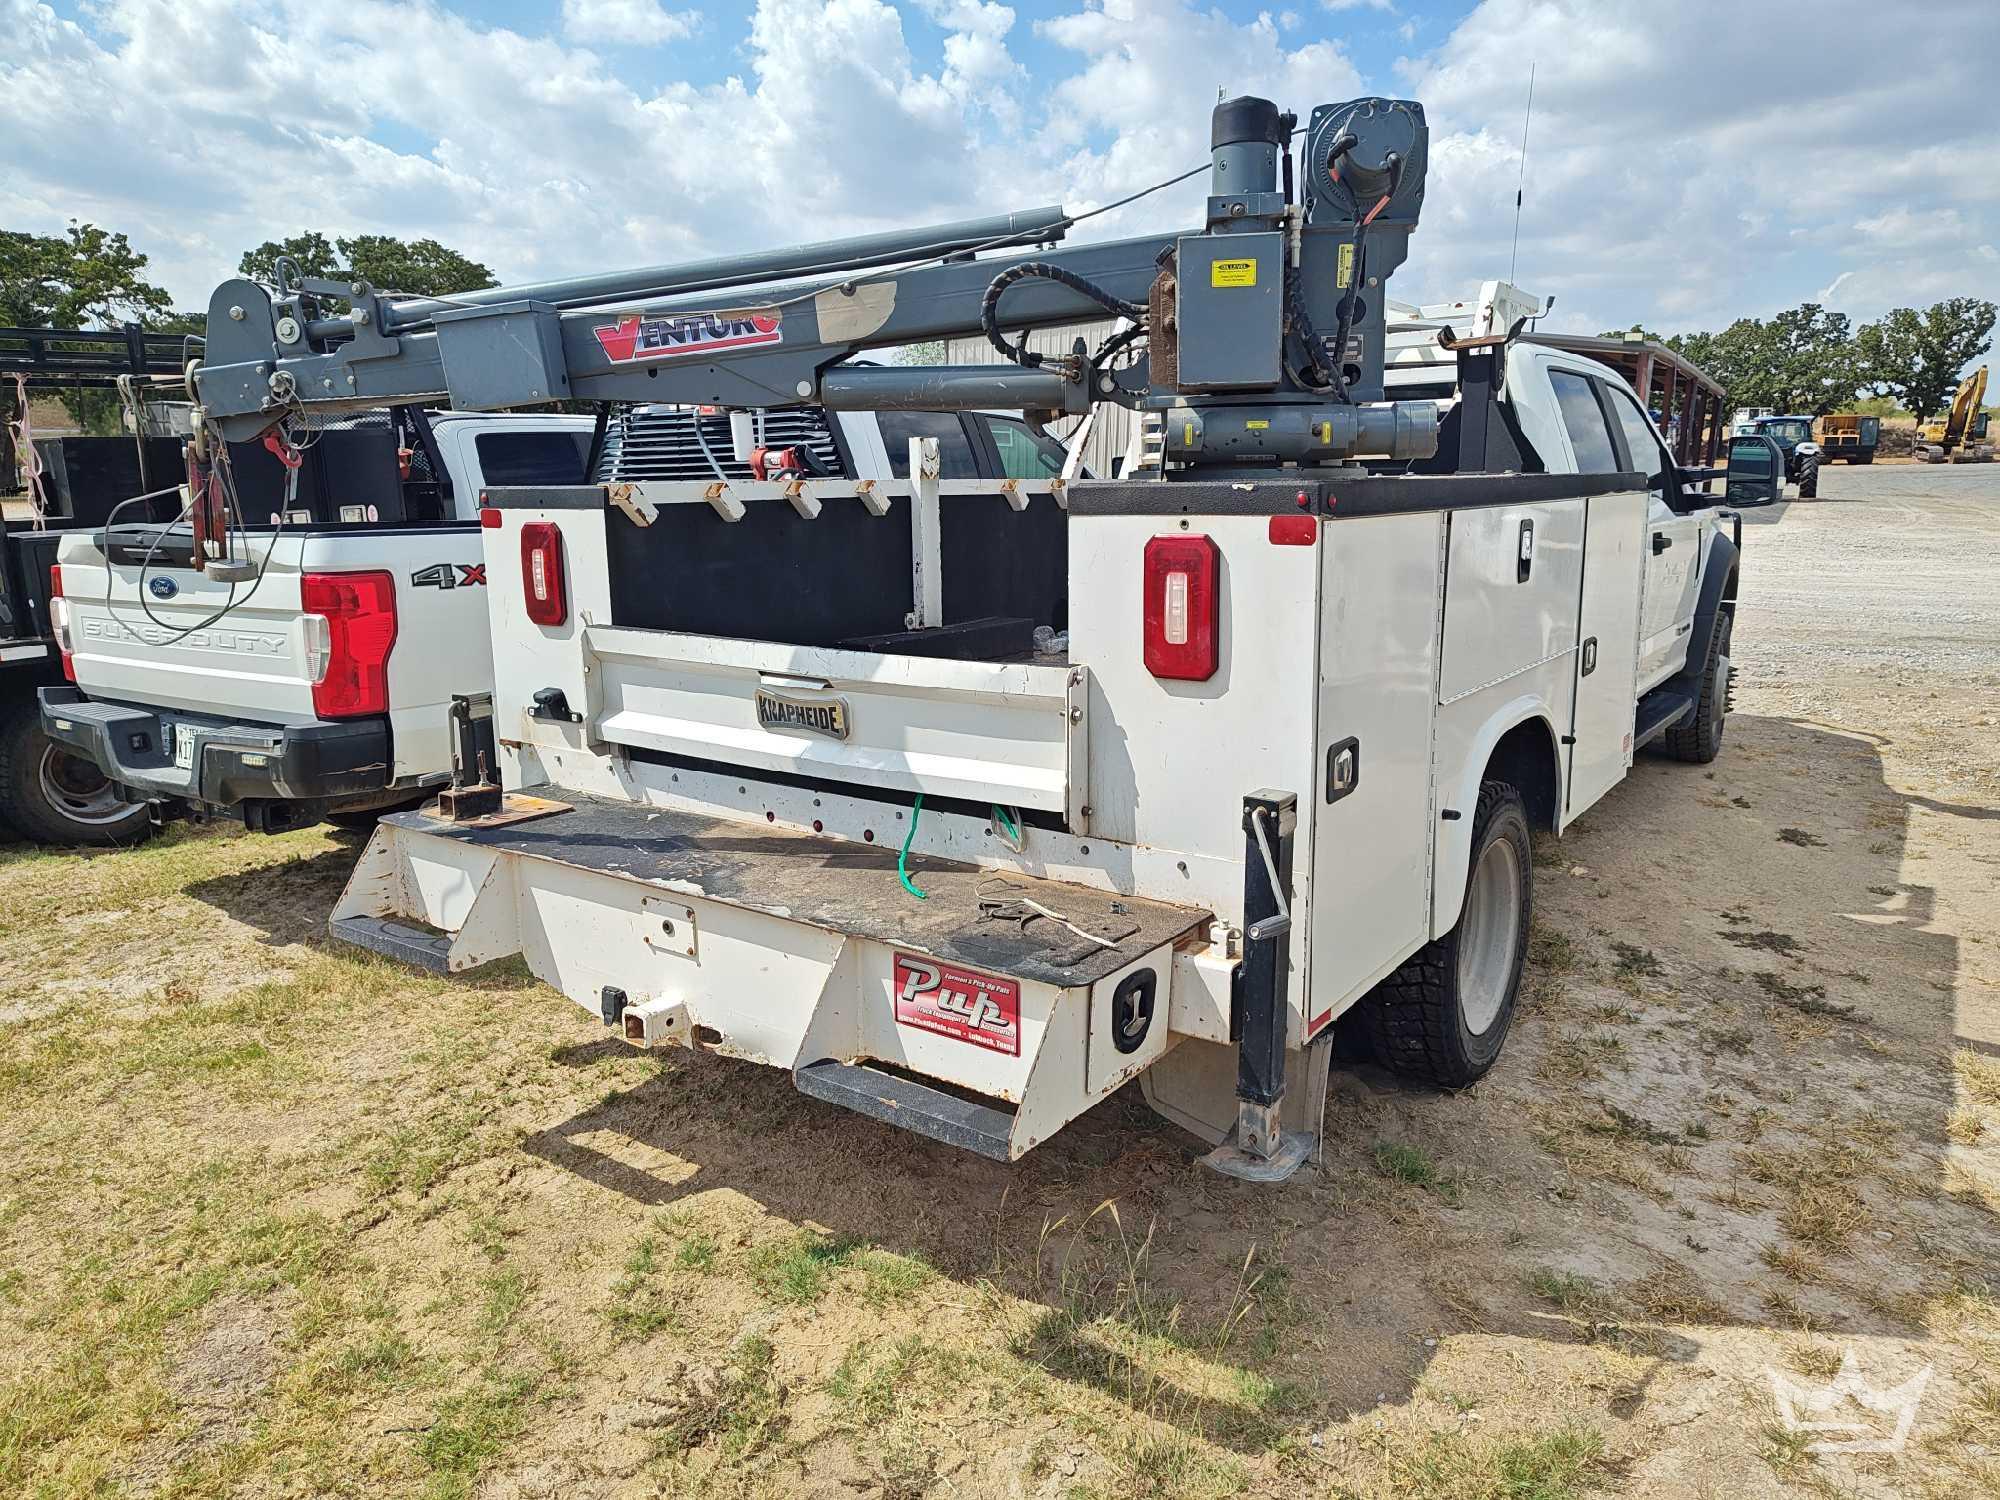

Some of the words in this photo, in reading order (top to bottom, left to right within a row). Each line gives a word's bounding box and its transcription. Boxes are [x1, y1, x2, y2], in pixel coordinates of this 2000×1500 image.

[595, 314, 780, 361] VENTURO
[86, 620, 182, 647] SUPER
[190, 631, 285, 653] DUTY
[758, 694, 840, 733] KNAPHEIDE
[898, 958, 1010, 1030] Pup
[995, 1039, 1015, 1052] Texas
